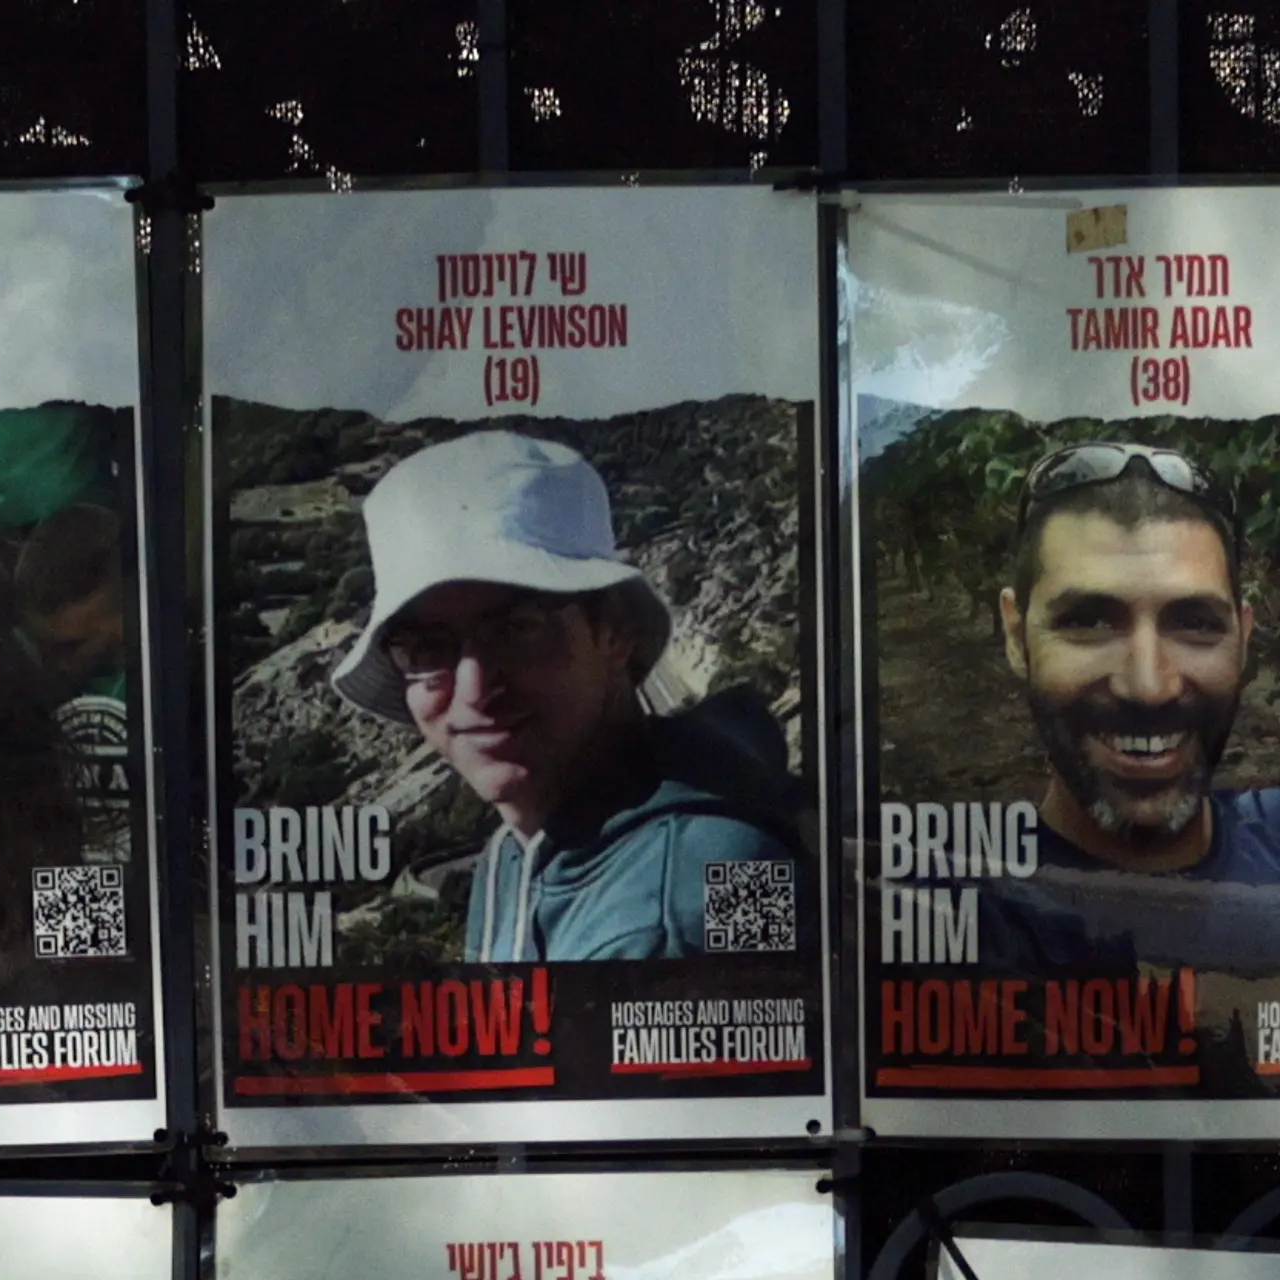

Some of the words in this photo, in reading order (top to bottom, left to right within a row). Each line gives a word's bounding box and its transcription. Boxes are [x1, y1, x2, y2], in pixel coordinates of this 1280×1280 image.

[437, 252, 536, 300] לוינסון
[549, 253, 588, 296] שי
[1090, 257, 1144, 297] אדר
[1158, 255, 1228, 296] תמיר
[397, 308, 472, 349] SHAY
[484, 306, 626, 348] LEVINSON
[1067, 307, 1158, 348] TAMIR
[1170, 306, 1251, 348] ADAR
[485, 358, 539, 405] (19)
[1131, 358, 1189, 405] (38)
[234, 805, 391, 885] BRING
[235, 892, 334, 969] HIM
[239, 983, 383, 1061] HOME
[403, 968, 553, 1057] NOW!
